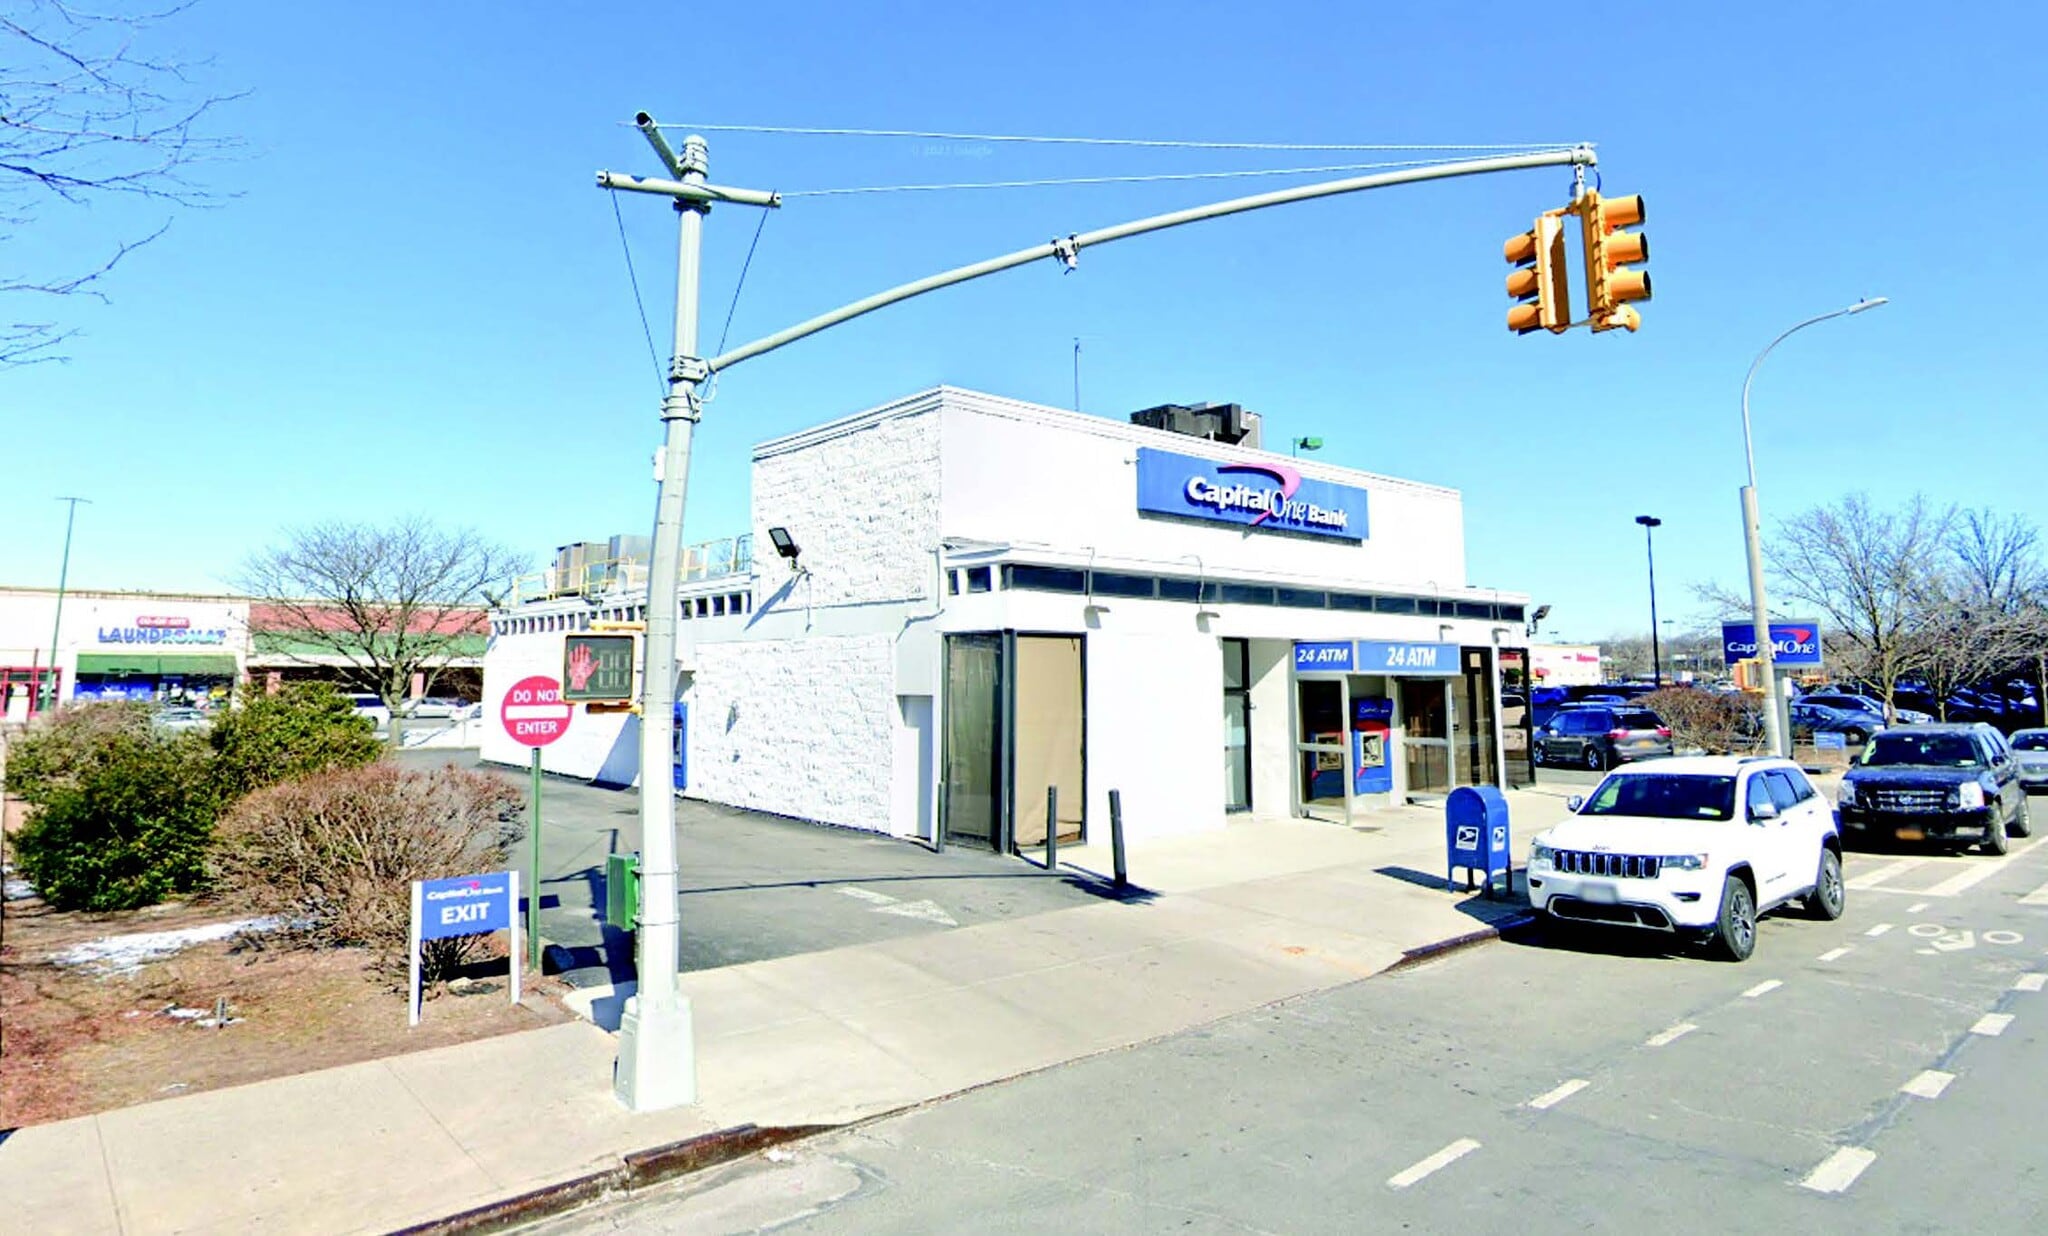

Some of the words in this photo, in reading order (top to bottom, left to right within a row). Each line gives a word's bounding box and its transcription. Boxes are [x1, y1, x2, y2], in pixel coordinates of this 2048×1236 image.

[1187, 476, 1270, 512] Capital
[1270, 490, 1307, 521] One
[1309, 504, 1349, 528] Bank
[98, 627, 227, 645] LAUNDROMAT
[1783, 639, 1815, 654] One
[1297, 648, 1315, 663] 24
[1316, 648, 1349, 663] ATM
[1386, 646, 1405, 666] 24
[1406, 647, 1437, 667] ATM
[513, 689, 532, 703] DO
[537, 689, 559, 702] NOT
[516, 720, 558, 735] ENTER
[440, 901, 491, 925] EXIT
